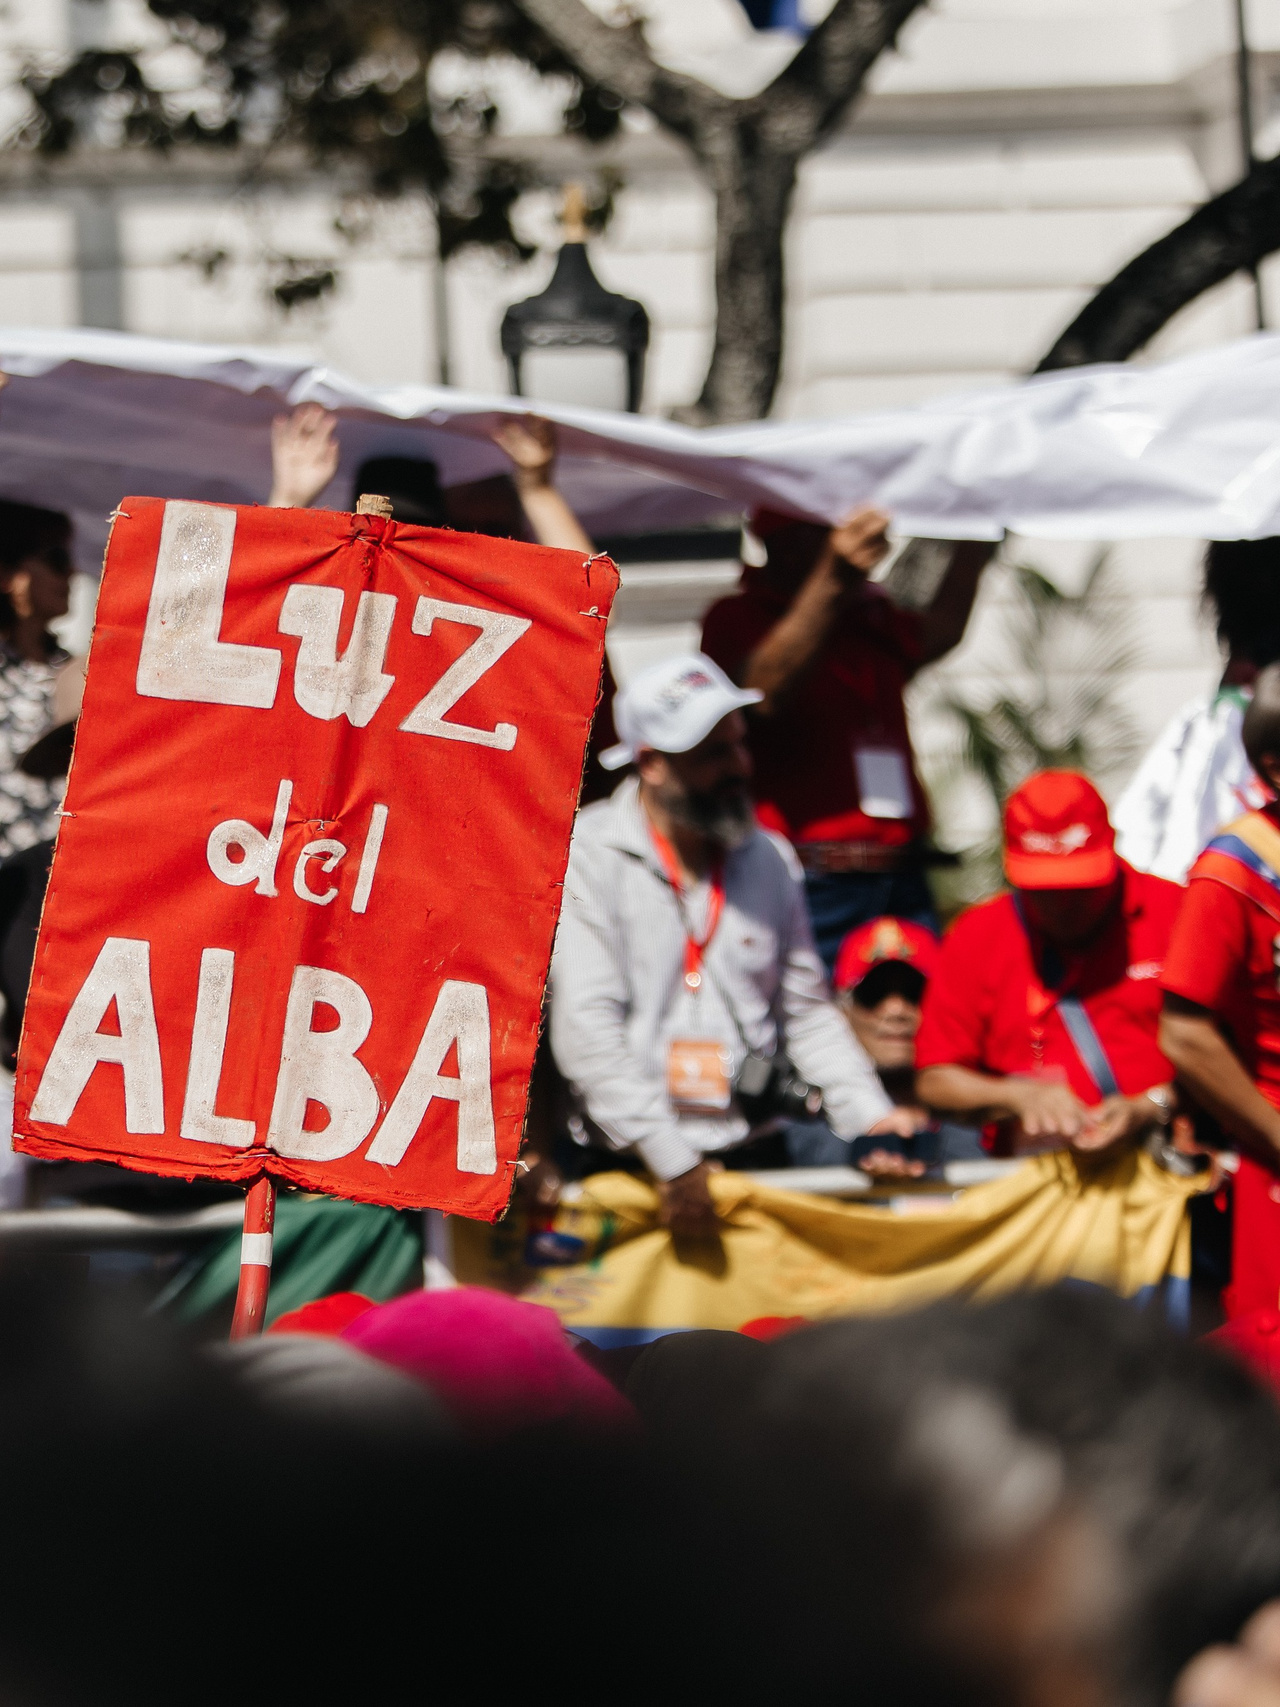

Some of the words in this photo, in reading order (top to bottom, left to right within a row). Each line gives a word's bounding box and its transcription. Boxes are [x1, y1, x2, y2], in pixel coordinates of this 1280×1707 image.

[135, 500, 532, 752] Luz
[205, 778, 390, 915] del
[28, 936, 499, 1176] ALBA
